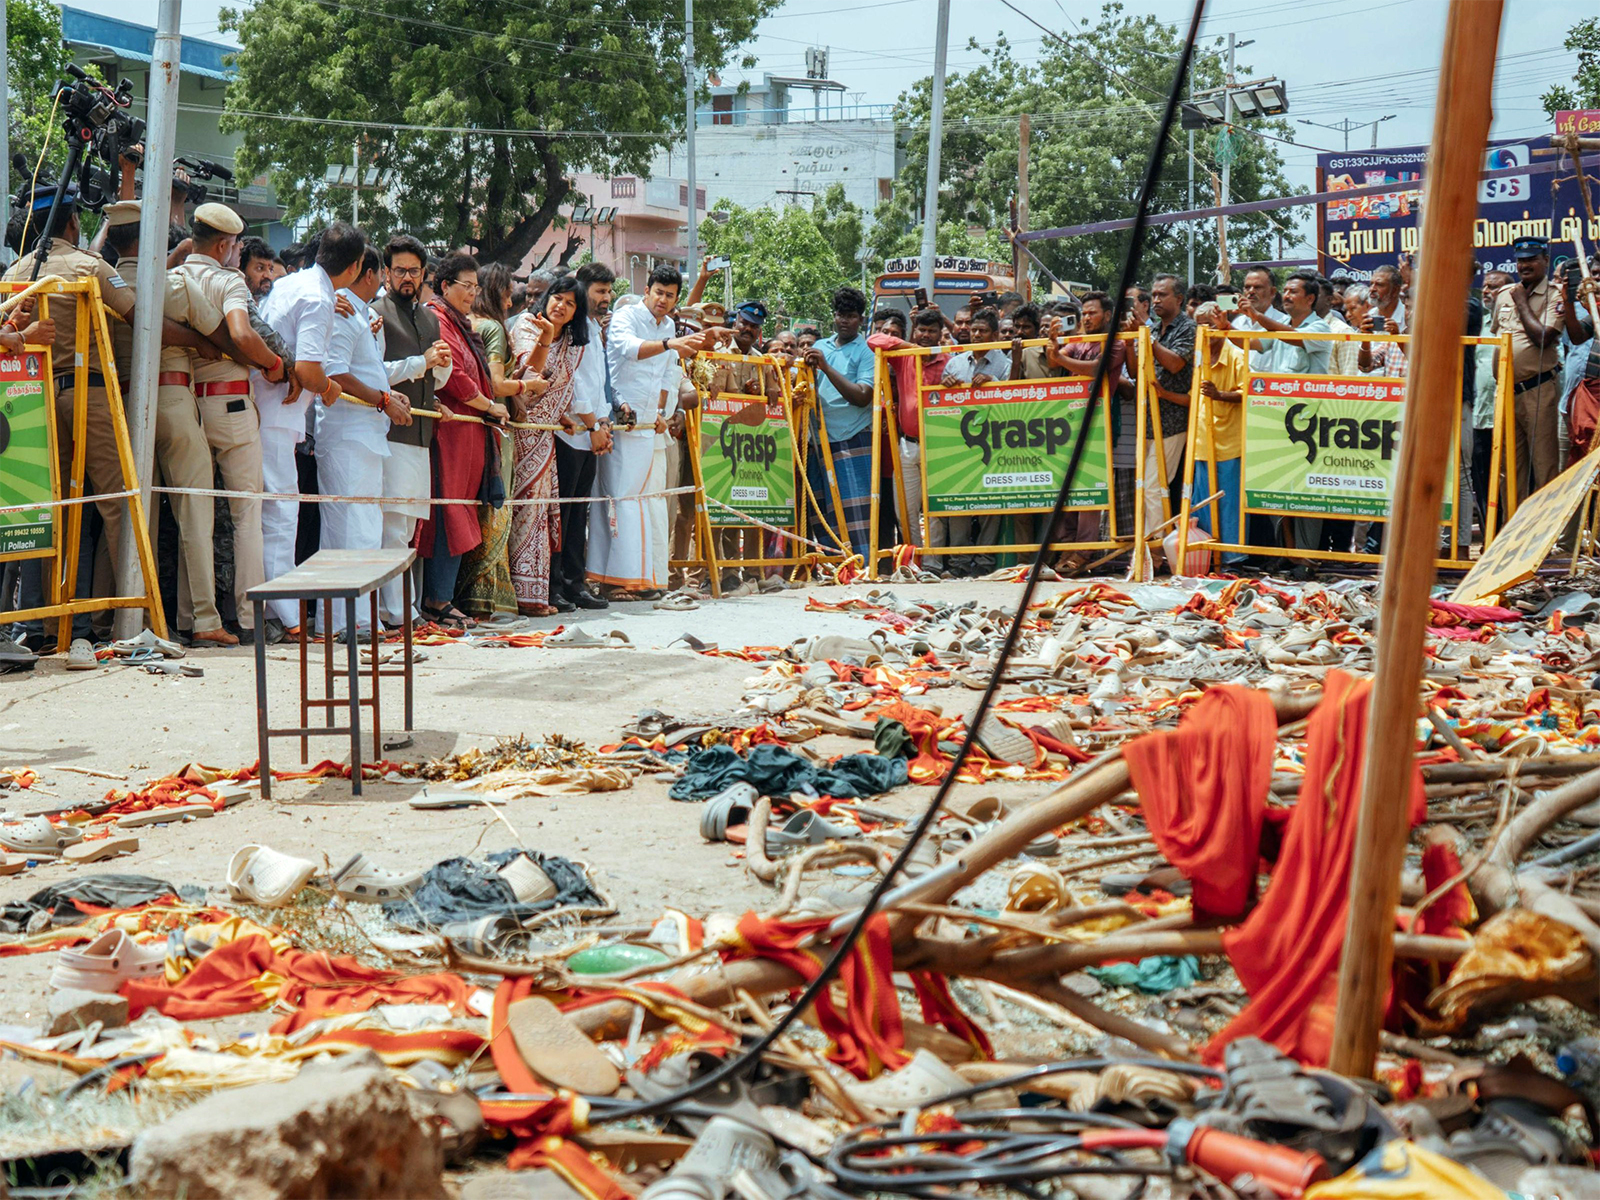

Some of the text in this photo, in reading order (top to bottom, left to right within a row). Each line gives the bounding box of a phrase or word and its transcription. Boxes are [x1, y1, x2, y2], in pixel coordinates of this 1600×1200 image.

[1486, 178, 1520, 198] SDS
[1328, 221, 1396, 262] சூர்யா
[0, 355, 21, 373] வல்
[944, 382, 1084, 404] கரூர் போக்குவரத்து காவல்
[1269, 380, 1301, 394] கரூர்
[1303, 381, 1387, 399] போக்குவரத்து
[709, 400, 728, 412] KARUR
[997, 455, 1043, 467] Clothings
[1323, 455, 1376, 470] Clothings
[739, 469, 764, 482] Clothings
[985, 475, 1013, 485] DRESS
[1029, 473, 1051, 483] LESS
[1308, 476, 1340, 487] DRESS
[1359, 479, 1384, 490] LESS
[732, 488, 748, 498] DRESS
[756, 489, 767, 499] LESS
[1261, 501, 1284, 510] Tirupur
[1289, 503, 1326, 512] Coimbatore
[1331, 505, 1352, 513] Salem
[14, 528, 30, 537] 99432
[30, 527, 46, 535] 10555
[8, 540, 36, 551] Pollachi
